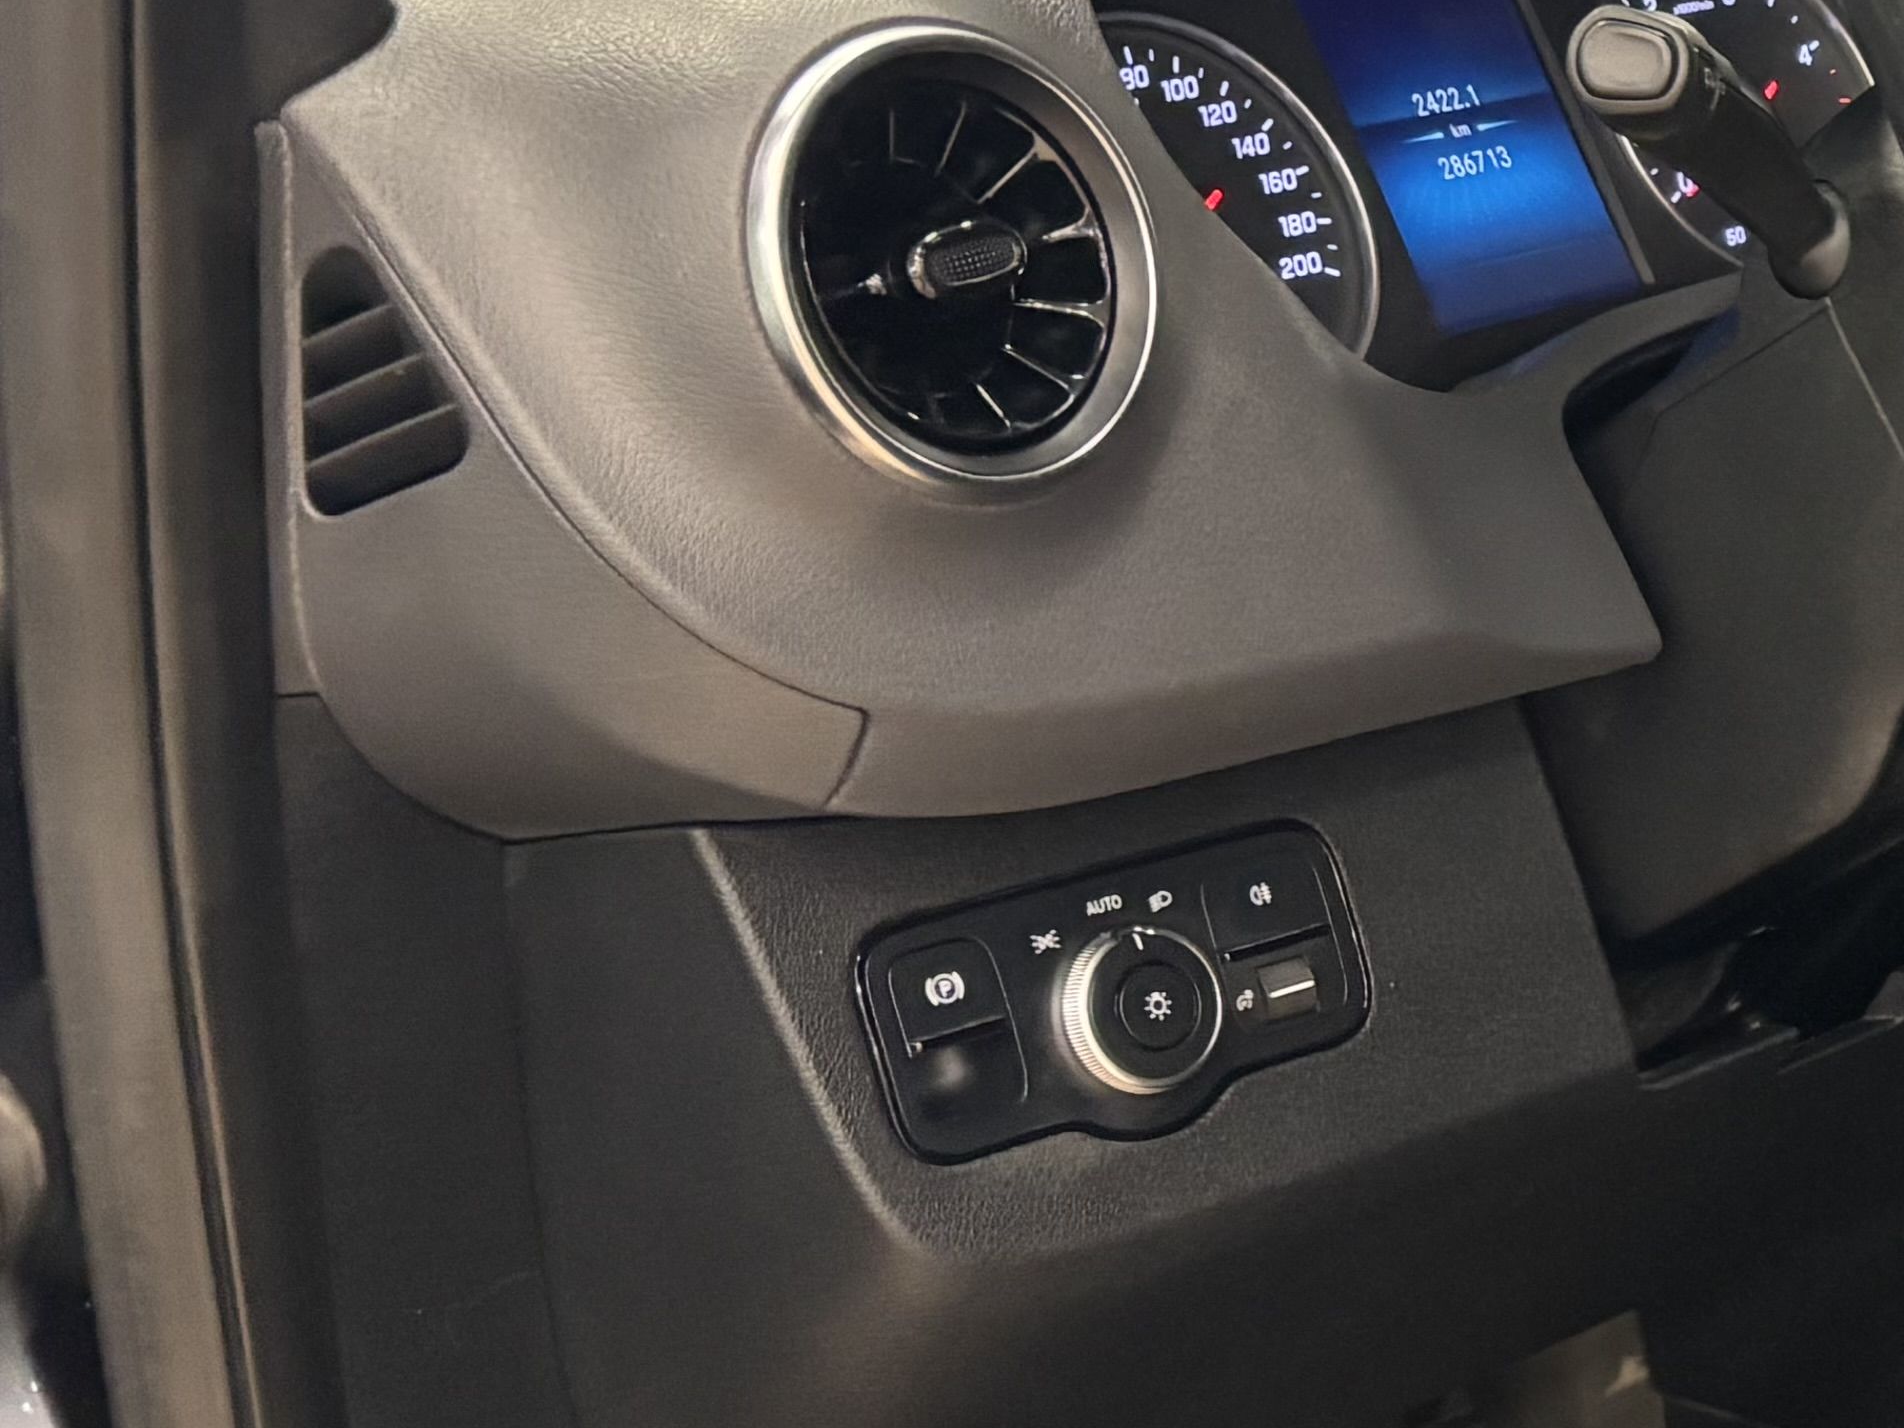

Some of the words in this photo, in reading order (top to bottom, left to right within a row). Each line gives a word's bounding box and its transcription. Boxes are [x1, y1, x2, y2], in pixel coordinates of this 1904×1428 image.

[1799, 43, 1813, 67] 4
[1160, 75, 1200, 103] 100
[1411, 84, 1481, 117] 2422.1
[1197, 100, 1238, 128] 120
[1450, 123, 1472, 138] km
[1231, 132, 1271, 160] 140
[1437, 145, 1512, 180] 286713
[1258, 168, 1298, 195] 160
[1277, 210, 1318, 238] 180
[1725, 225, 1747, 247] 50
[1278, 251, 1323, 280] 200
[1086, 894, 1123, 917] AUTO
